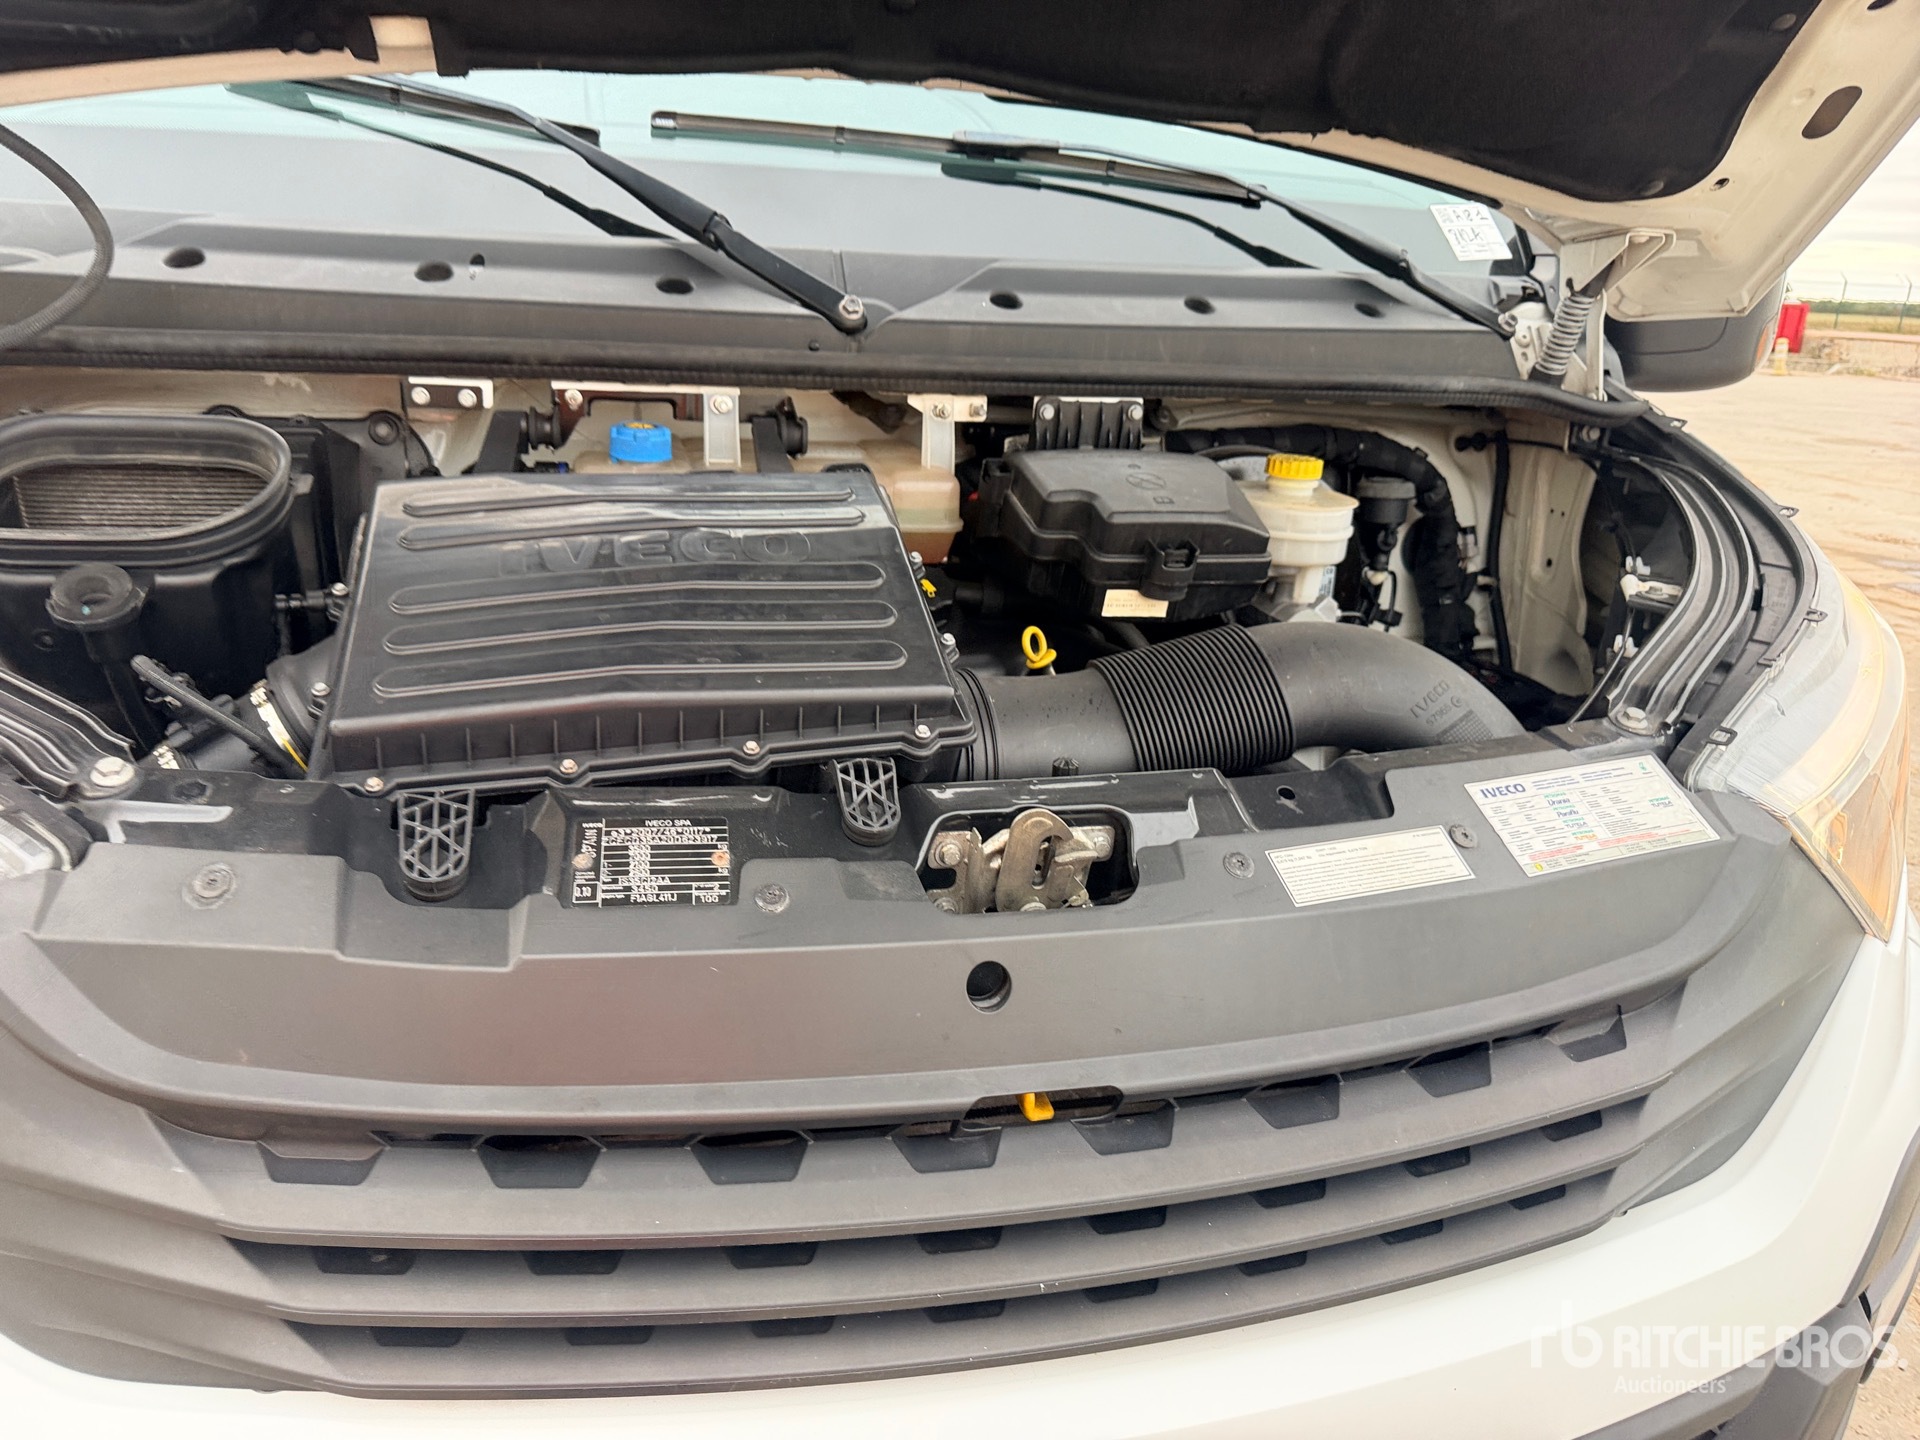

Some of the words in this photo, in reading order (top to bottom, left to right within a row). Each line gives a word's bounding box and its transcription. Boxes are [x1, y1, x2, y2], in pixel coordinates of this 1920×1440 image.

[498, 530, 811, 577] IVECO
[1480, 783, 1527, 799] IVECO
[645, 820, 672, 828] IVECO
[674, 820, 692, 828] SPA
[700, 895, 719, 903] 100
